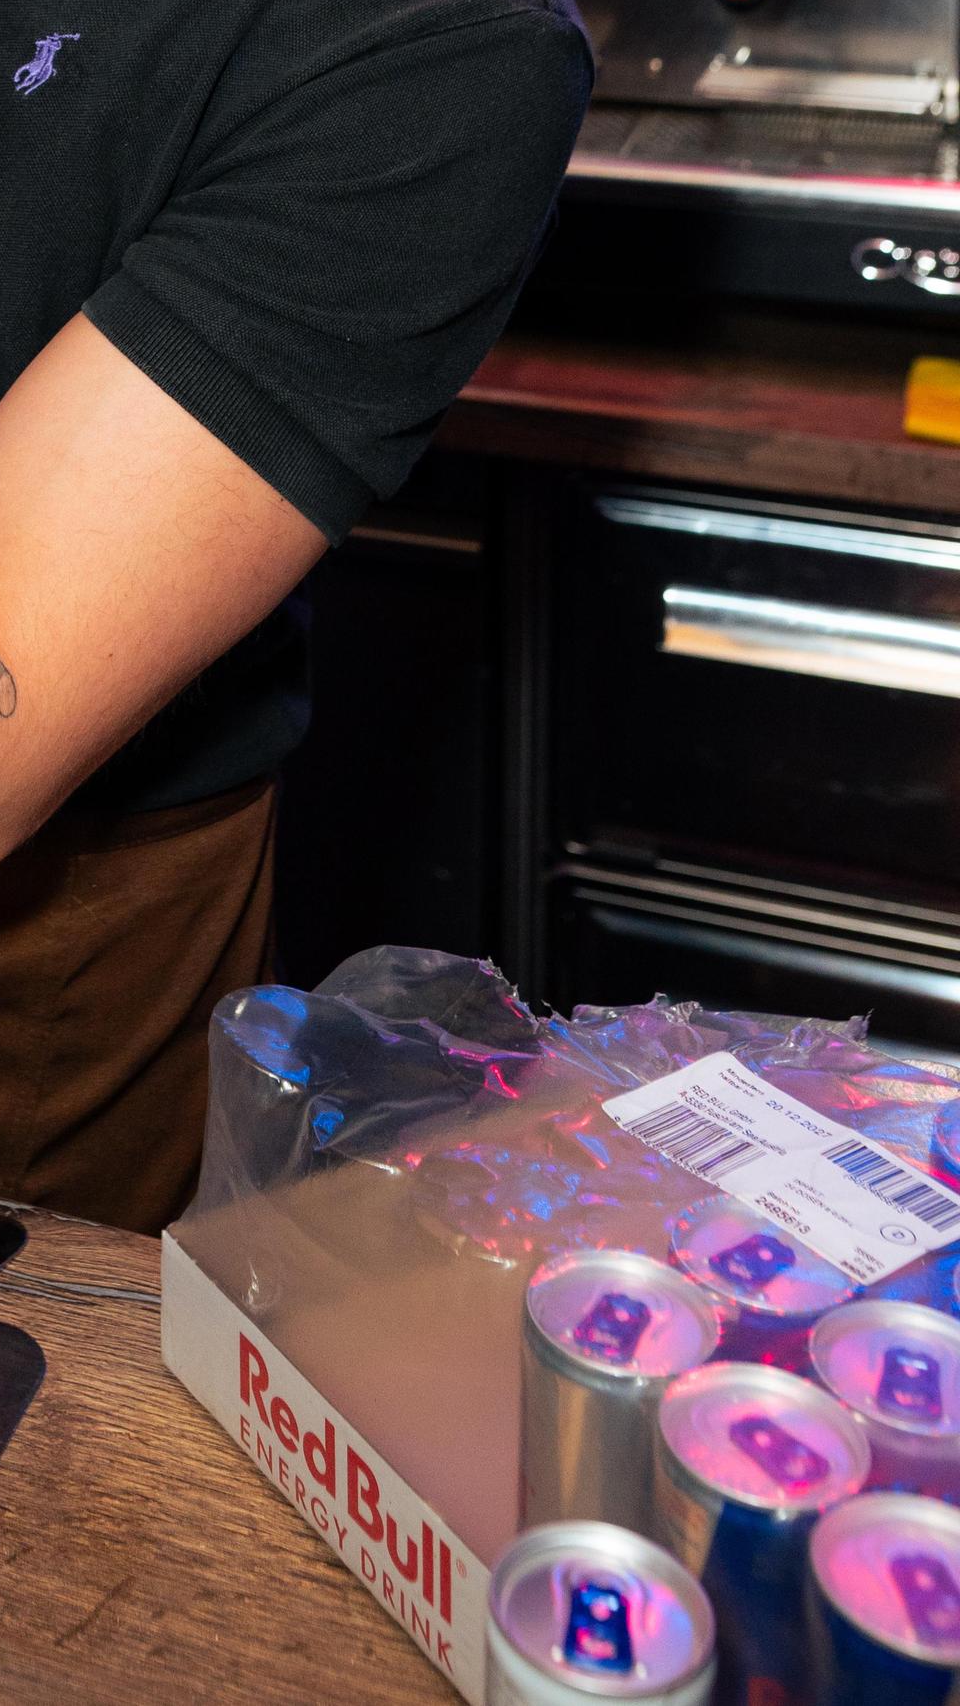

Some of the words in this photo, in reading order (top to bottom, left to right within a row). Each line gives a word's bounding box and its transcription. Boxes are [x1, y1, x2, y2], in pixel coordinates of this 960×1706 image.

[690, 1084, 711, 1100] RED
[707, 1096, 730, 1112] BULL
[765, 1099, 833, 1139] 20.12.2027
[239, 1331, 337, 1500] Red
[346, 1444, 453, 1627] Bull
[240, 1413, 349, 1554] ENERGY
[360, 1547, 453, 1673] DRINK
